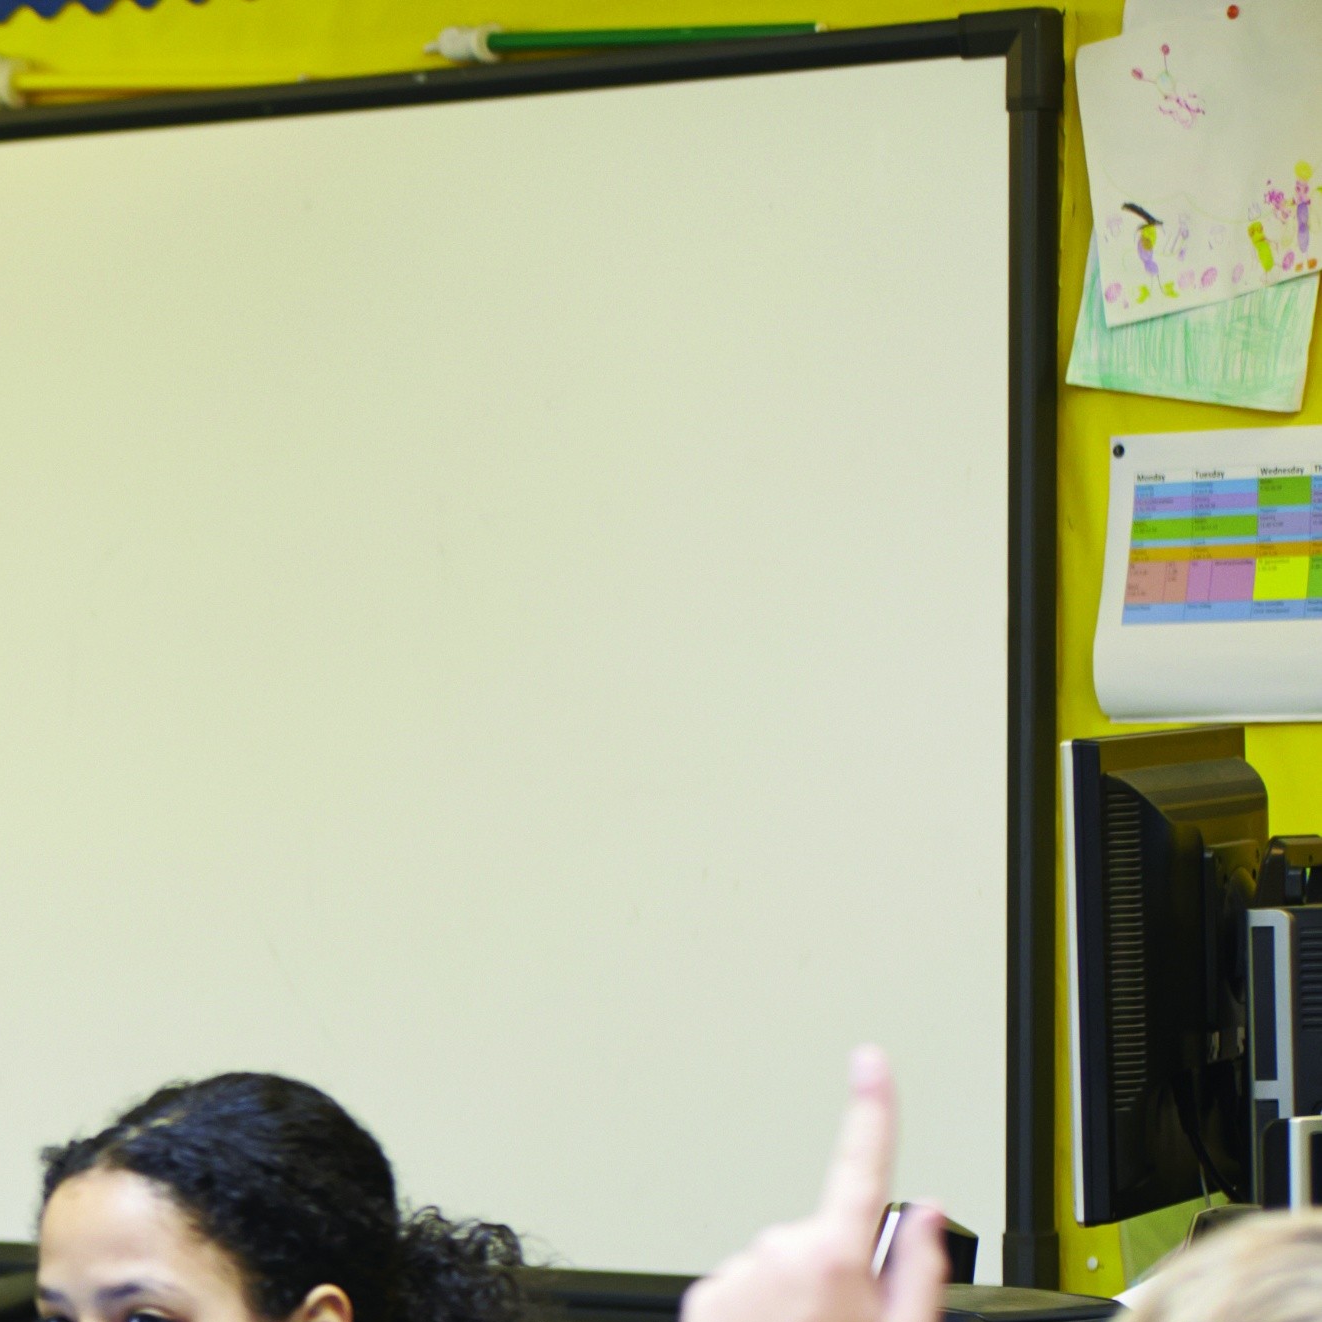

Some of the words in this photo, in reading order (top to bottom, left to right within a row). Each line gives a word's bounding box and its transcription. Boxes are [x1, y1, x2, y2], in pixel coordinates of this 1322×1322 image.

[1136, 472, 1166, 482] Monday
[1195, 469, 1225, 480] Tuesday
[1260, 465, 1304, 476] Wednesday
